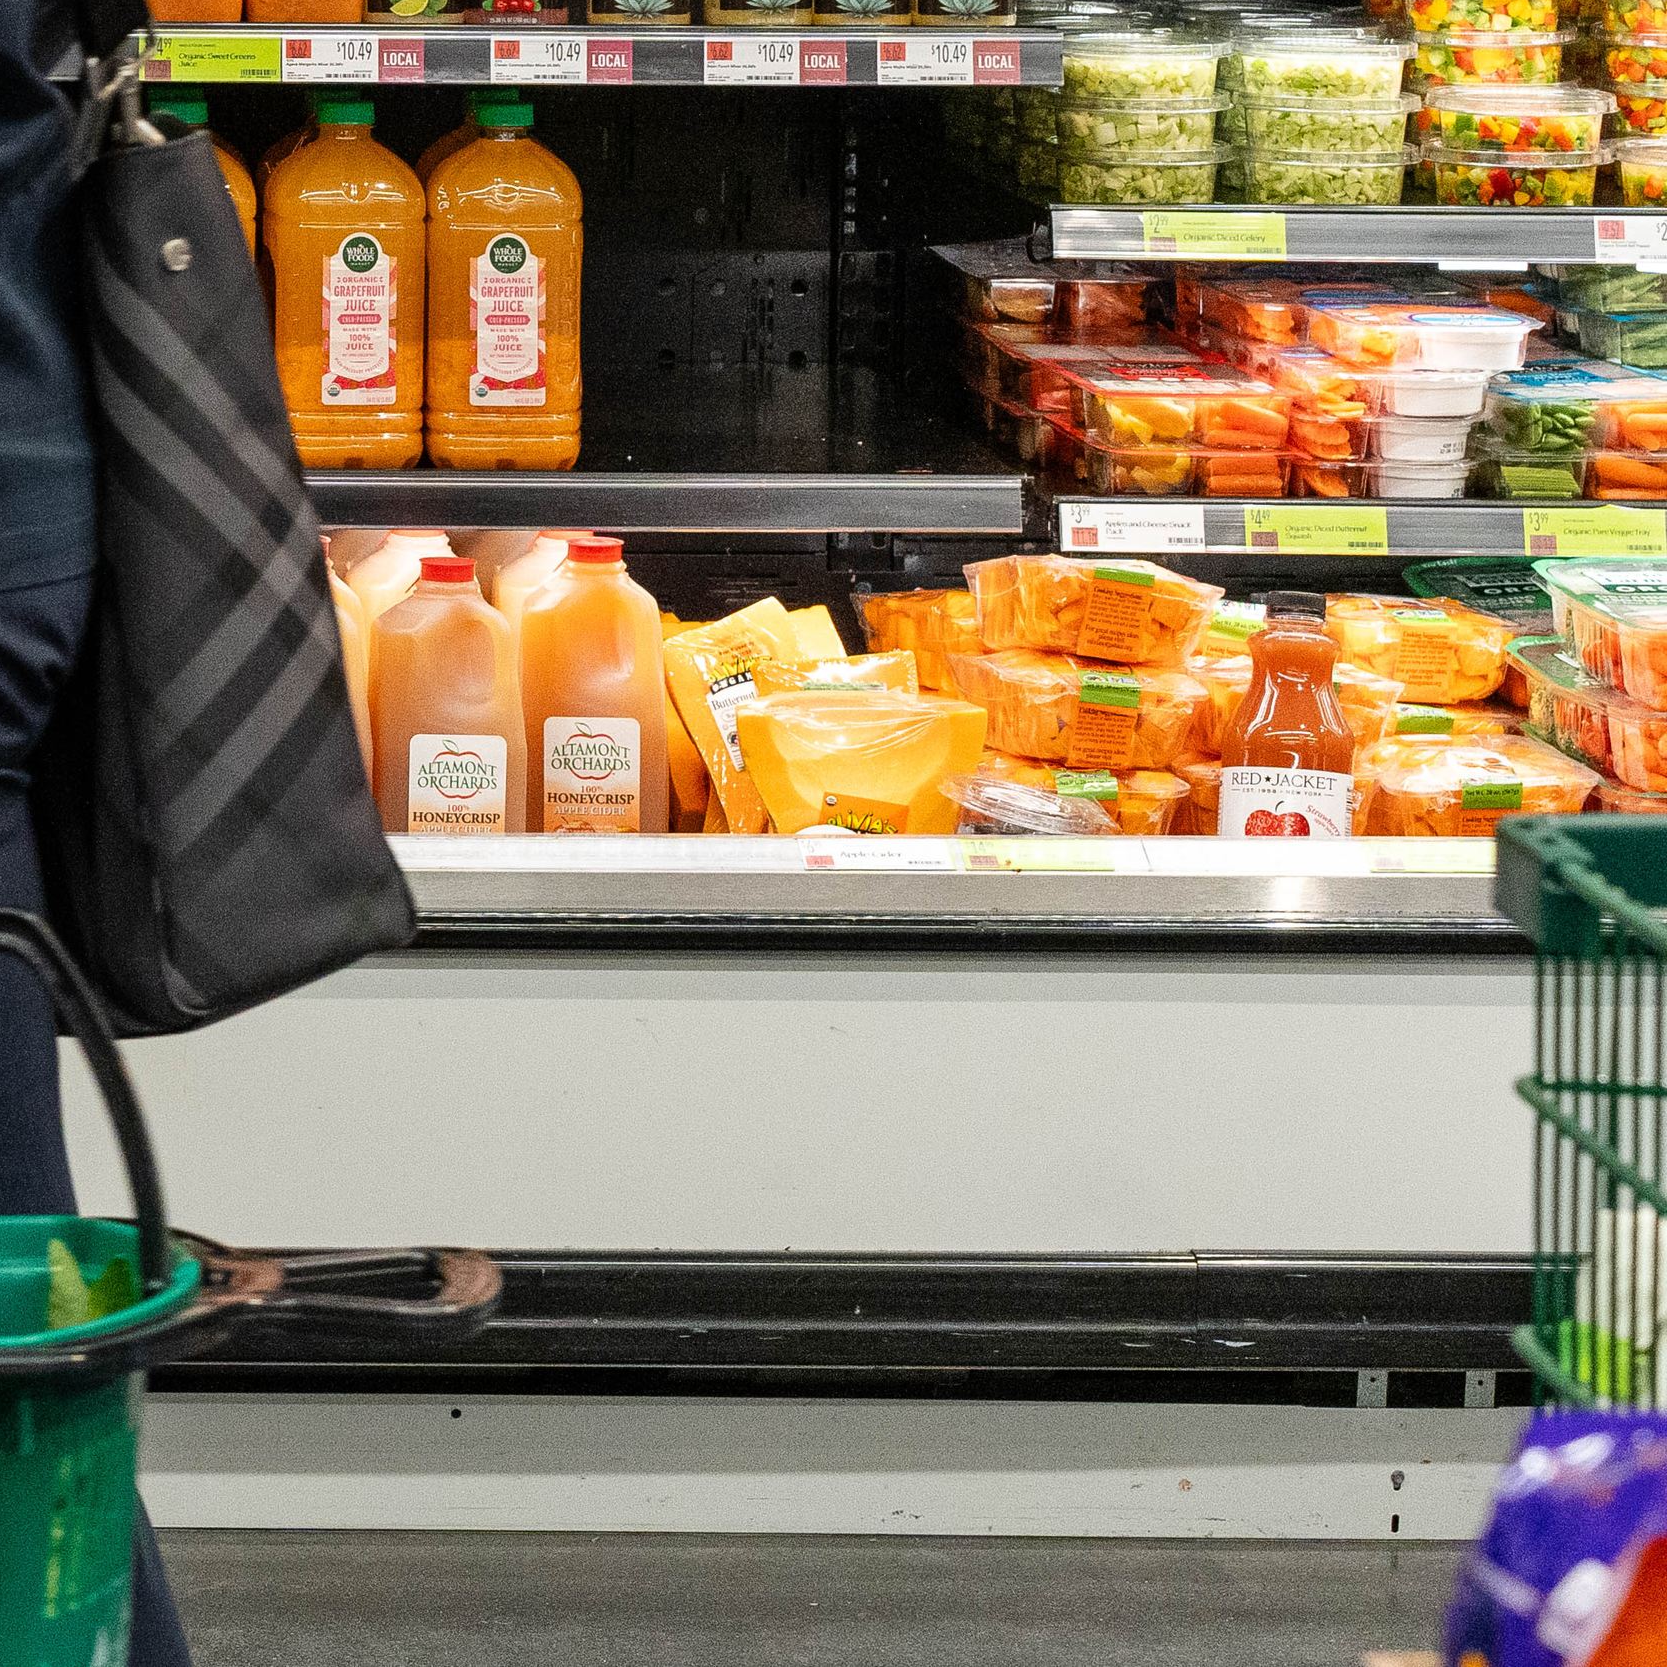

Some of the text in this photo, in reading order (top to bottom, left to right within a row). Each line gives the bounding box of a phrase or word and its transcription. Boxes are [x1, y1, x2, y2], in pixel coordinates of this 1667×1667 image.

[337, 40, 373, 62] $10.49
[546, 40, 581, 62] $10.49
[931, 44, 967, 63] $10.49
[383, 52, 420, 66] LOCAL
[592, 54, 628, 68] LOCAL
[978, 54, 1015, 68] LOCAL
[333, 284, 385, 298] GRAPEFRUIT
[344, 300, 376, 312] JUICE
[345, 343, 374, 351] JUICE
[552, 742, 631, 759] ALTAMONT
[418, 761, 497, 778] ALTAMONT
[551, 757, 631, 772] ORCHARDS
[417, 776, 497, 789] ORCHARDS
[1231, 772, 1338, 792] RED JACKET
[547, 792, 635, 808] HONEYCRISP
[447, 804, 470, 812] 100%
[554, 806, 626, 816] APPLE CIDER
[412, 811, 500, 825] HONEYCRISP
